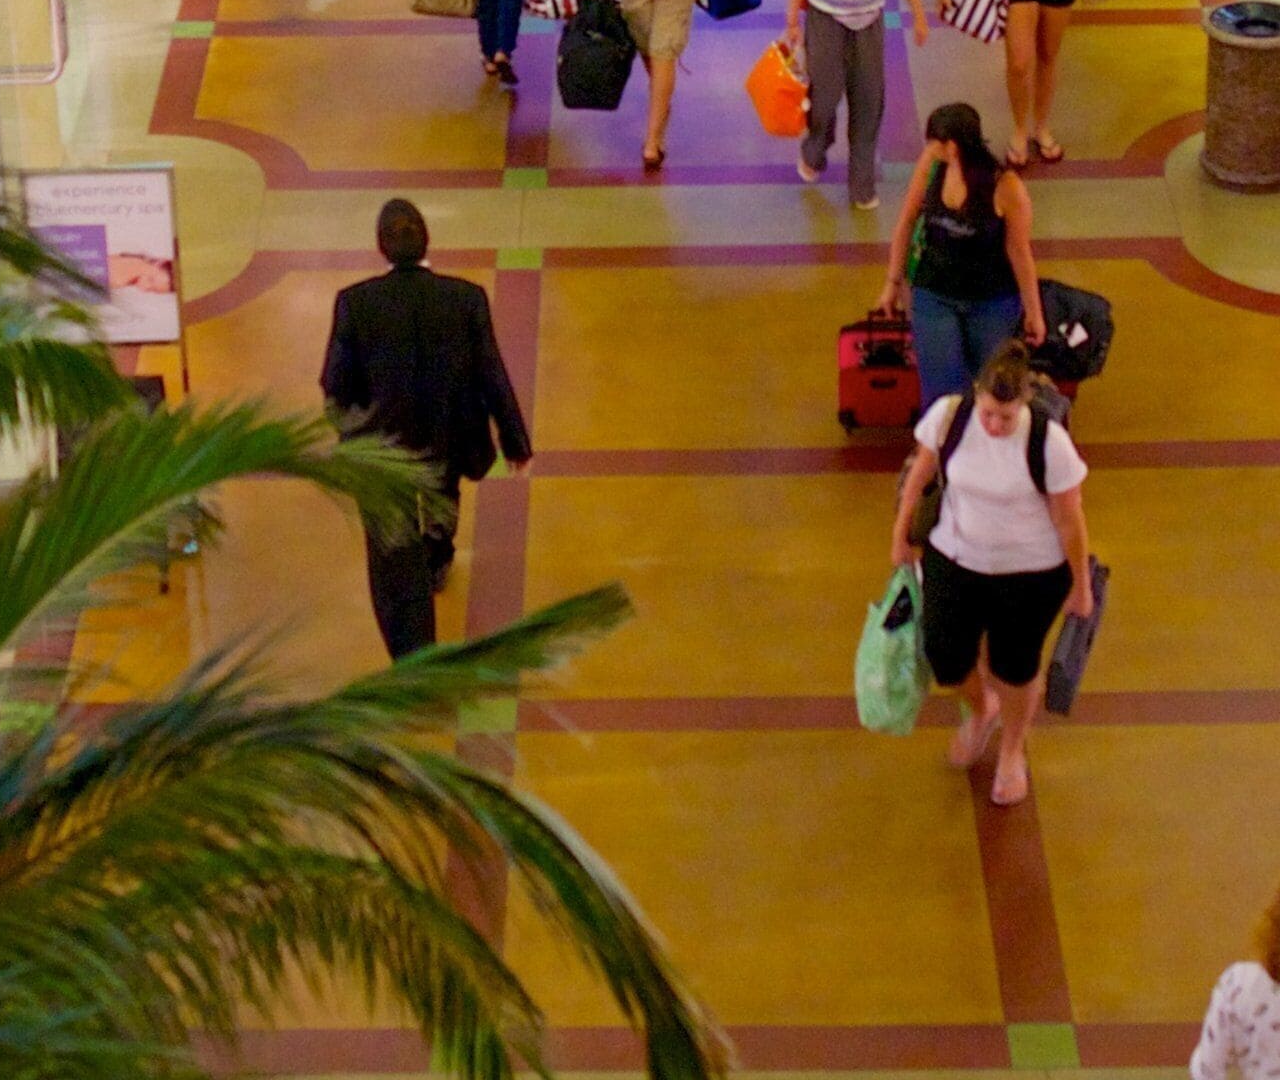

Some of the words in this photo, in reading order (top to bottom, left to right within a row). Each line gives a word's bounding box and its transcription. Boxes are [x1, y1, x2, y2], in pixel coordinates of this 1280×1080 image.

[50, 185, 147, 199] experience
[34, 203, 133, 218] bluemercury
[138, 204, 164, 216] spa
